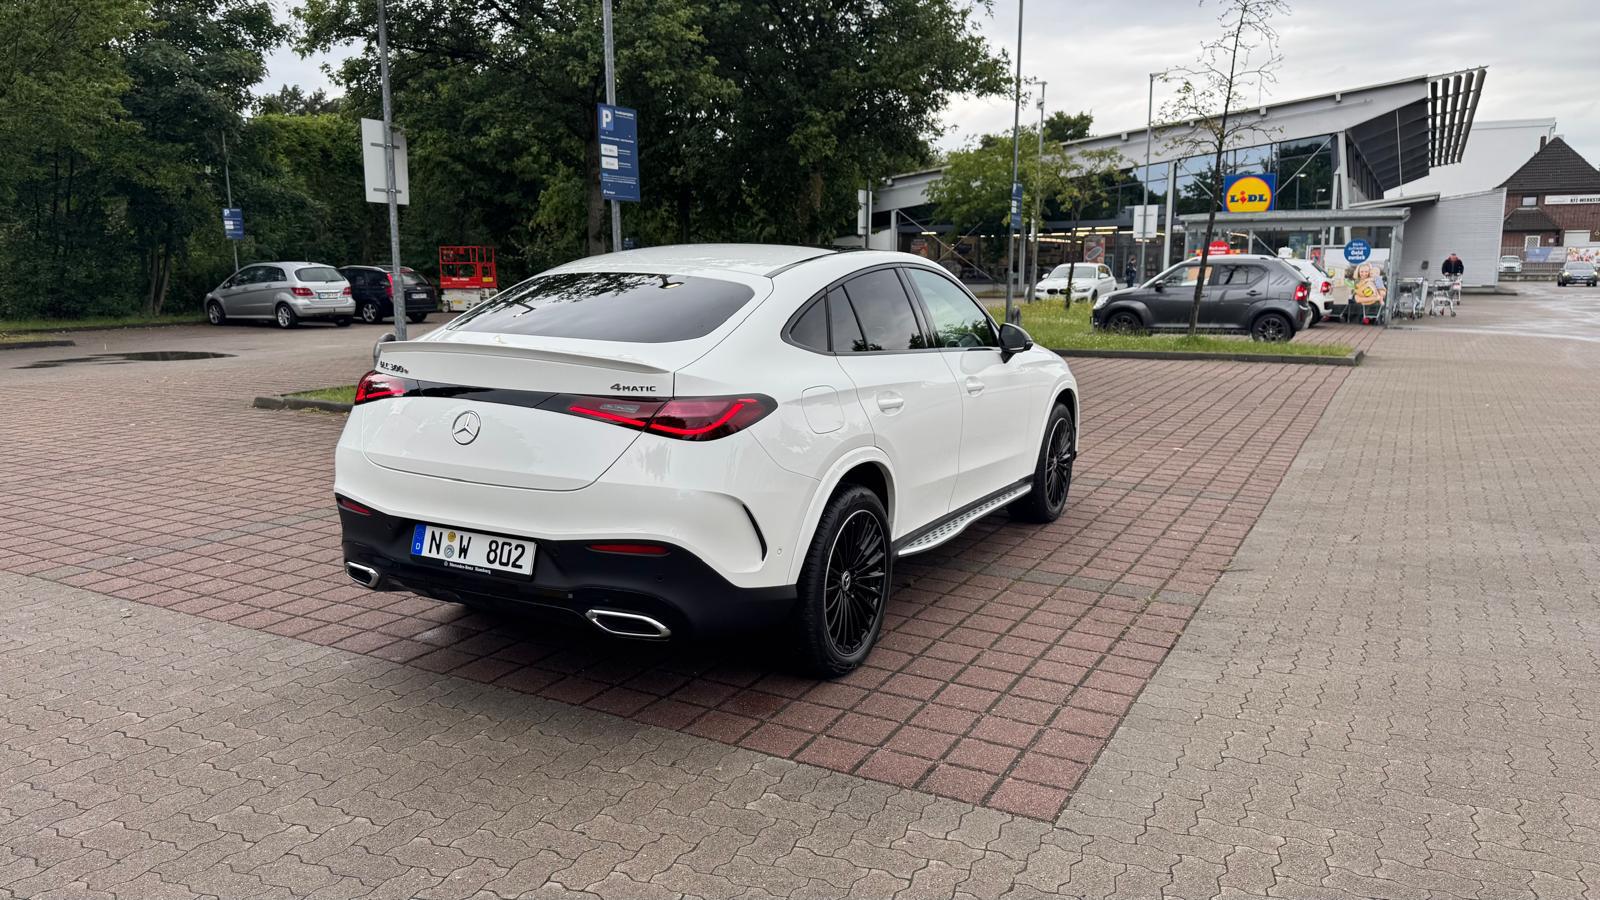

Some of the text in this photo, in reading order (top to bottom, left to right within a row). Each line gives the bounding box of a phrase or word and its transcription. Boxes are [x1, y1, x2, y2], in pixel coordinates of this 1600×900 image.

[602, 110, 612, 128] P
[610, 383, 656, 392] 4MATIC
[428, 530, 526, 569] N W 802
